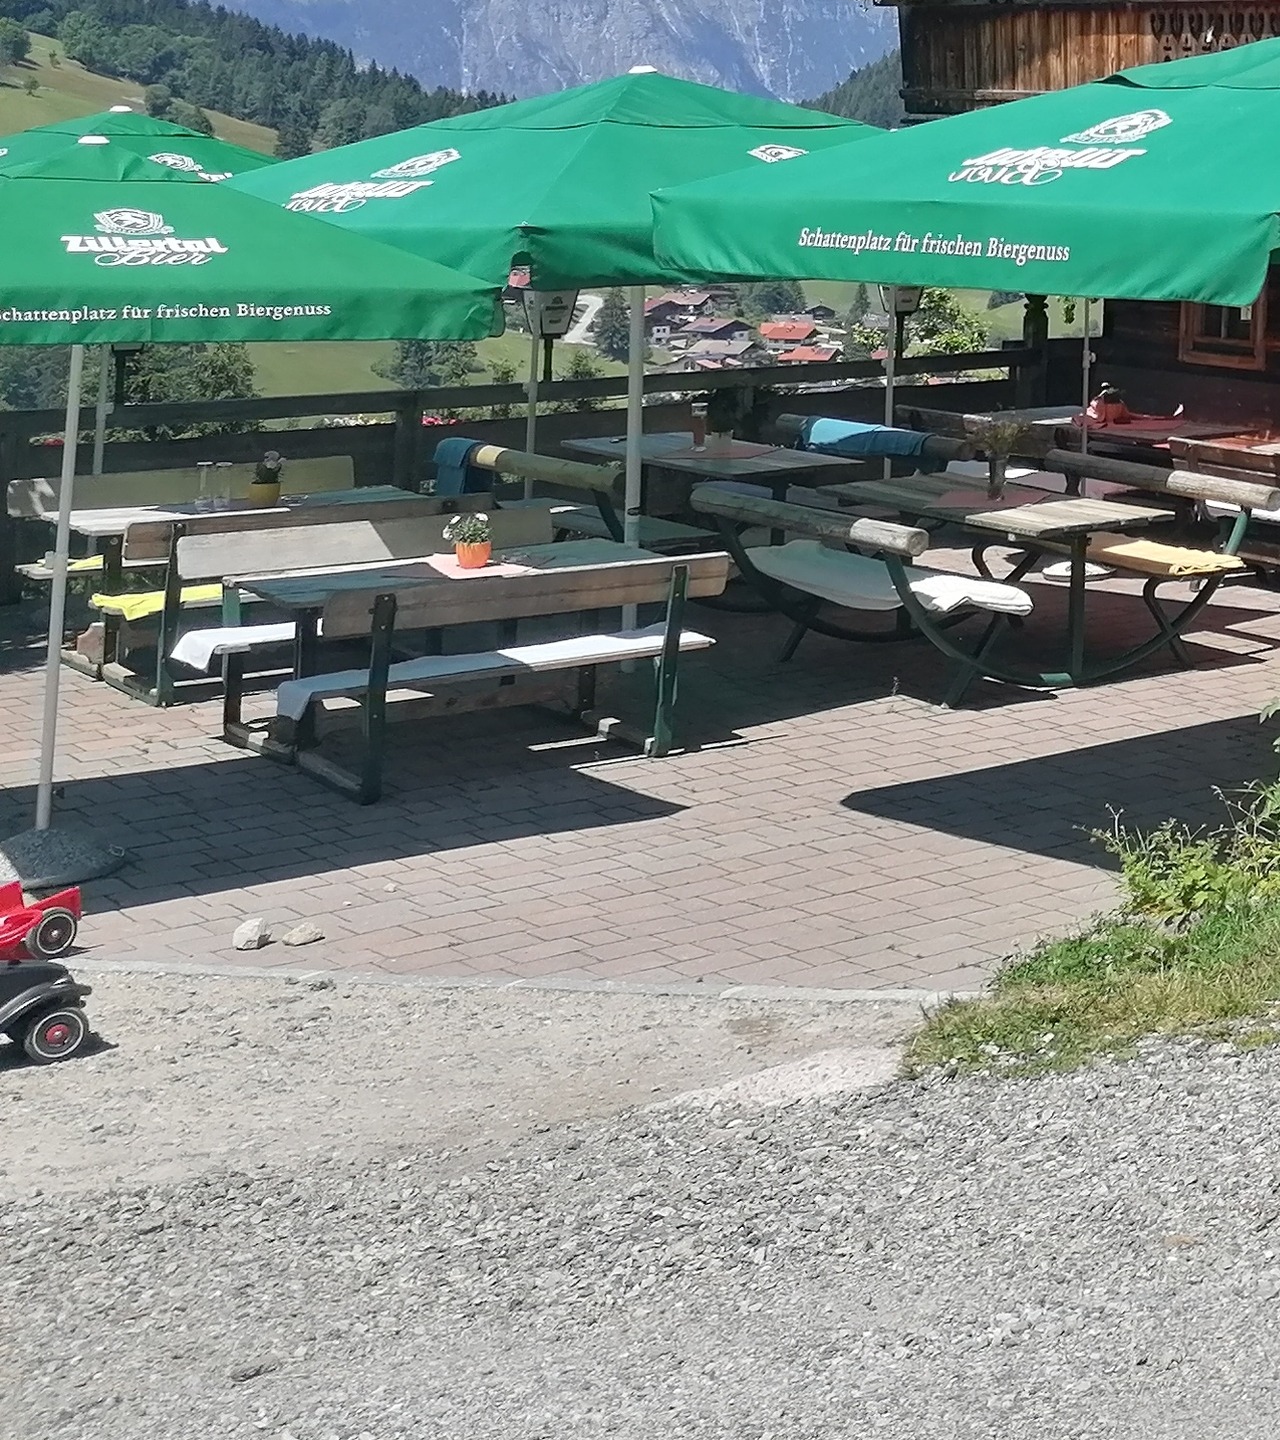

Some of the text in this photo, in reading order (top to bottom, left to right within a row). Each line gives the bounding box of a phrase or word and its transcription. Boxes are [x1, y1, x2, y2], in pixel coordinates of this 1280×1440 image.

[60, 235, 229, 253] Zillertal
[798, 227, 1070, 266] Schattenplatz für frischen Biergenuss
[94, 246, 213, 266] Bier
[0, 302, 332, 324] chattenplatz für frischen Biergenuss
